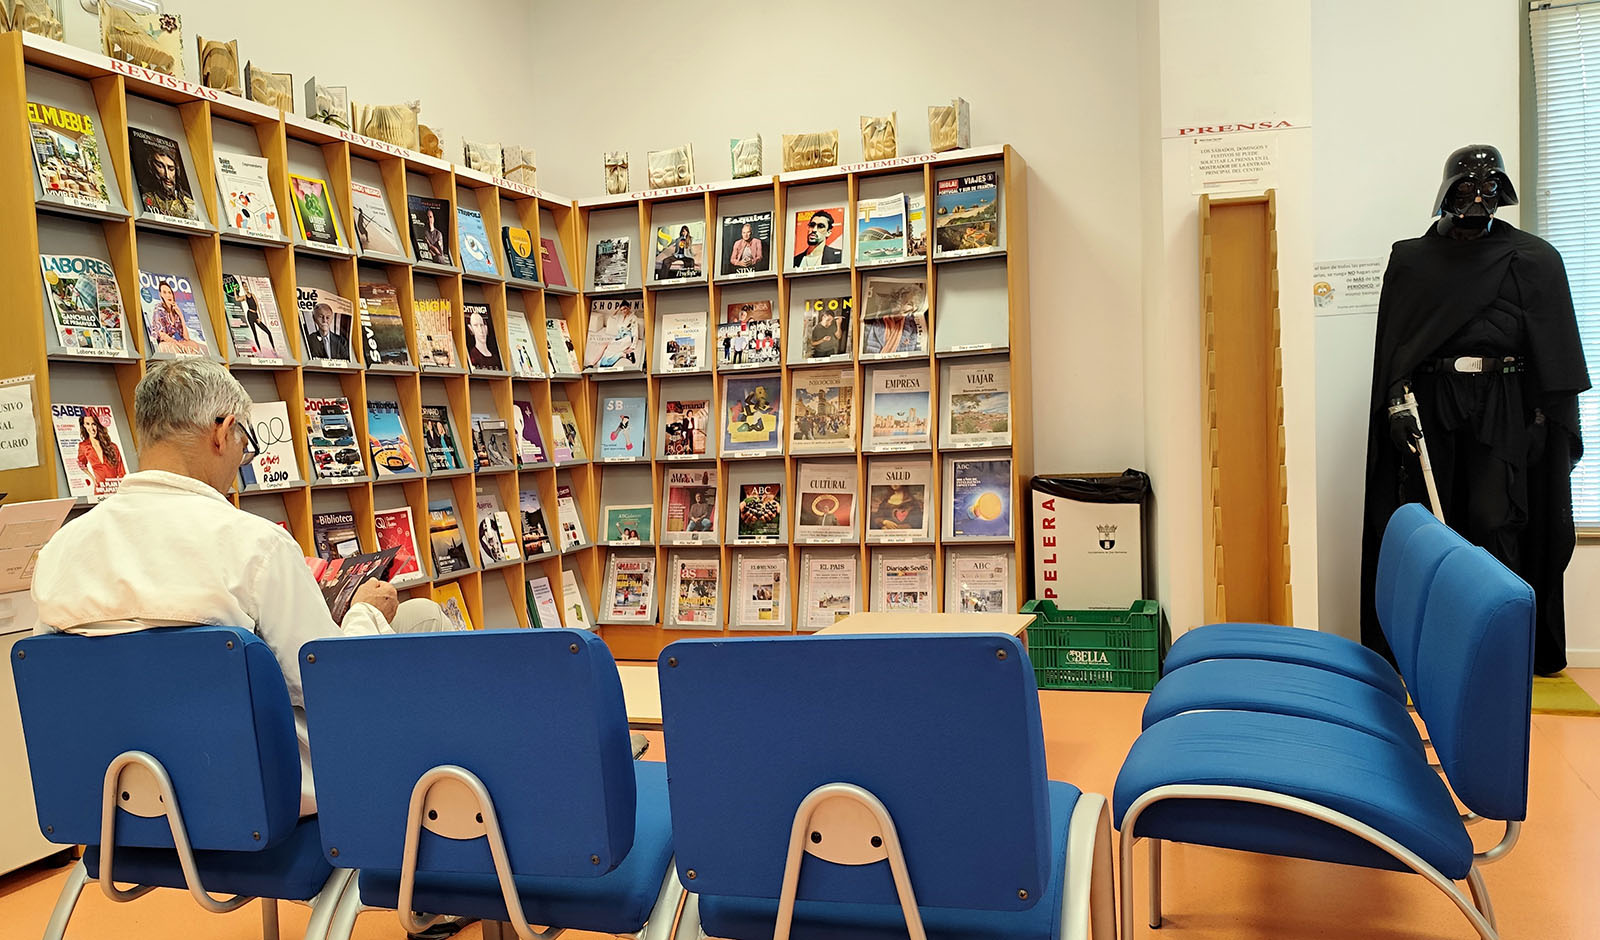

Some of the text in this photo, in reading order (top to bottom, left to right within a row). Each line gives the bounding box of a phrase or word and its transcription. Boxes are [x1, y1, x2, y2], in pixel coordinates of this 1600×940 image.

[109, 58, 219, 101] REVISTAS
[27, 103, 94, 136] EL MUEBLE
[1179, 121, 1293, 136] PRENSA
[340, 130, 410, 157] REVISTAS
[840, 154, 937, 173] SUPLEMENTOS
[963, 175, 987, 185] VIAJES
[492, 177, 543, 197] REVISTAS
[631, 184, 715, 199] CULTURAL
[724, 214, 771, 225] Esquire
[41, 256, 114, 278] LABORES
[805, 298, 852, 312] ICON
[61, 312, 96, 322] GANCHILLO
[884, 378, 919, 389] EMPRESA
[965, 373, 993, 385] VIAJAR
[0, 437, 29, 450] CARIO
[886, 472, 911, 481] SALUD
[751, 486, 771, 494] ABC
[810, 479, 847, 489] CULTURAL
[319, 514, 353, 525] Biblioteca
[1042, 498, 1058, 599] PELERA
[973, 562, 991, 570] ABC
[1075, 650, 1109, 663] BELLA
